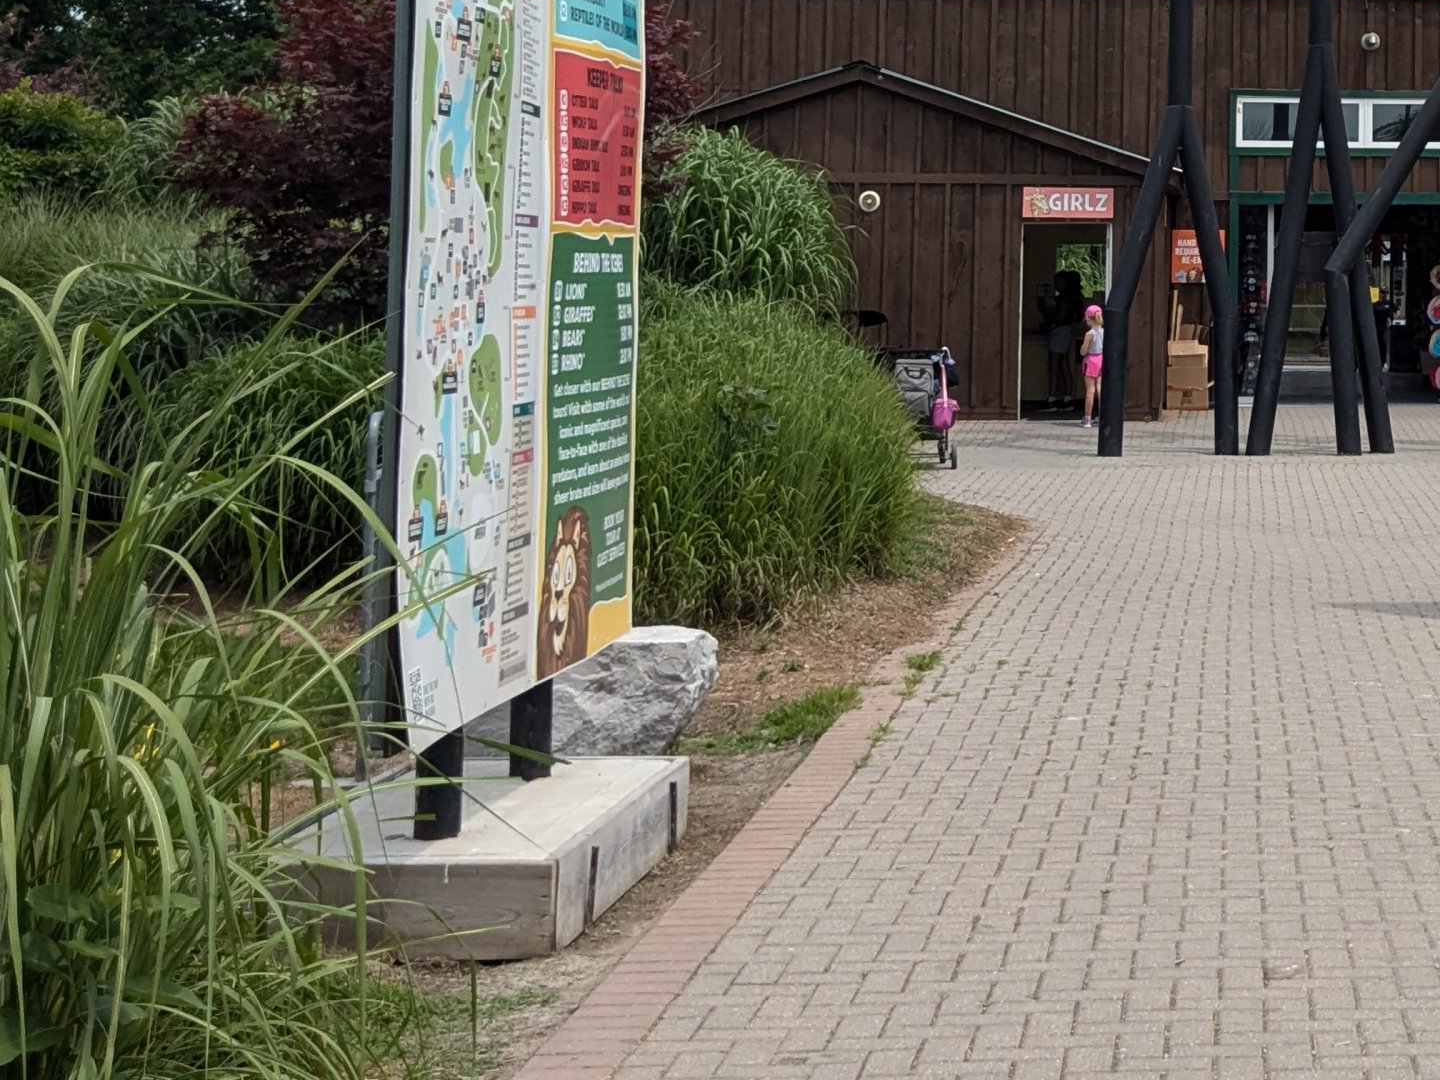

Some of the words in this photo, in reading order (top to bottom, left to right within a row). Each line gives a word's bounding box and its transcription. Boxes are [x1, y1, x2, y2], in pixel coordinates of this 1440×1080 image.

[1049, 192, 1109, 212] GIRLZ
[1177, 239, 1197, 247] HAND
[573, 252, 600, 274] BEHIND
